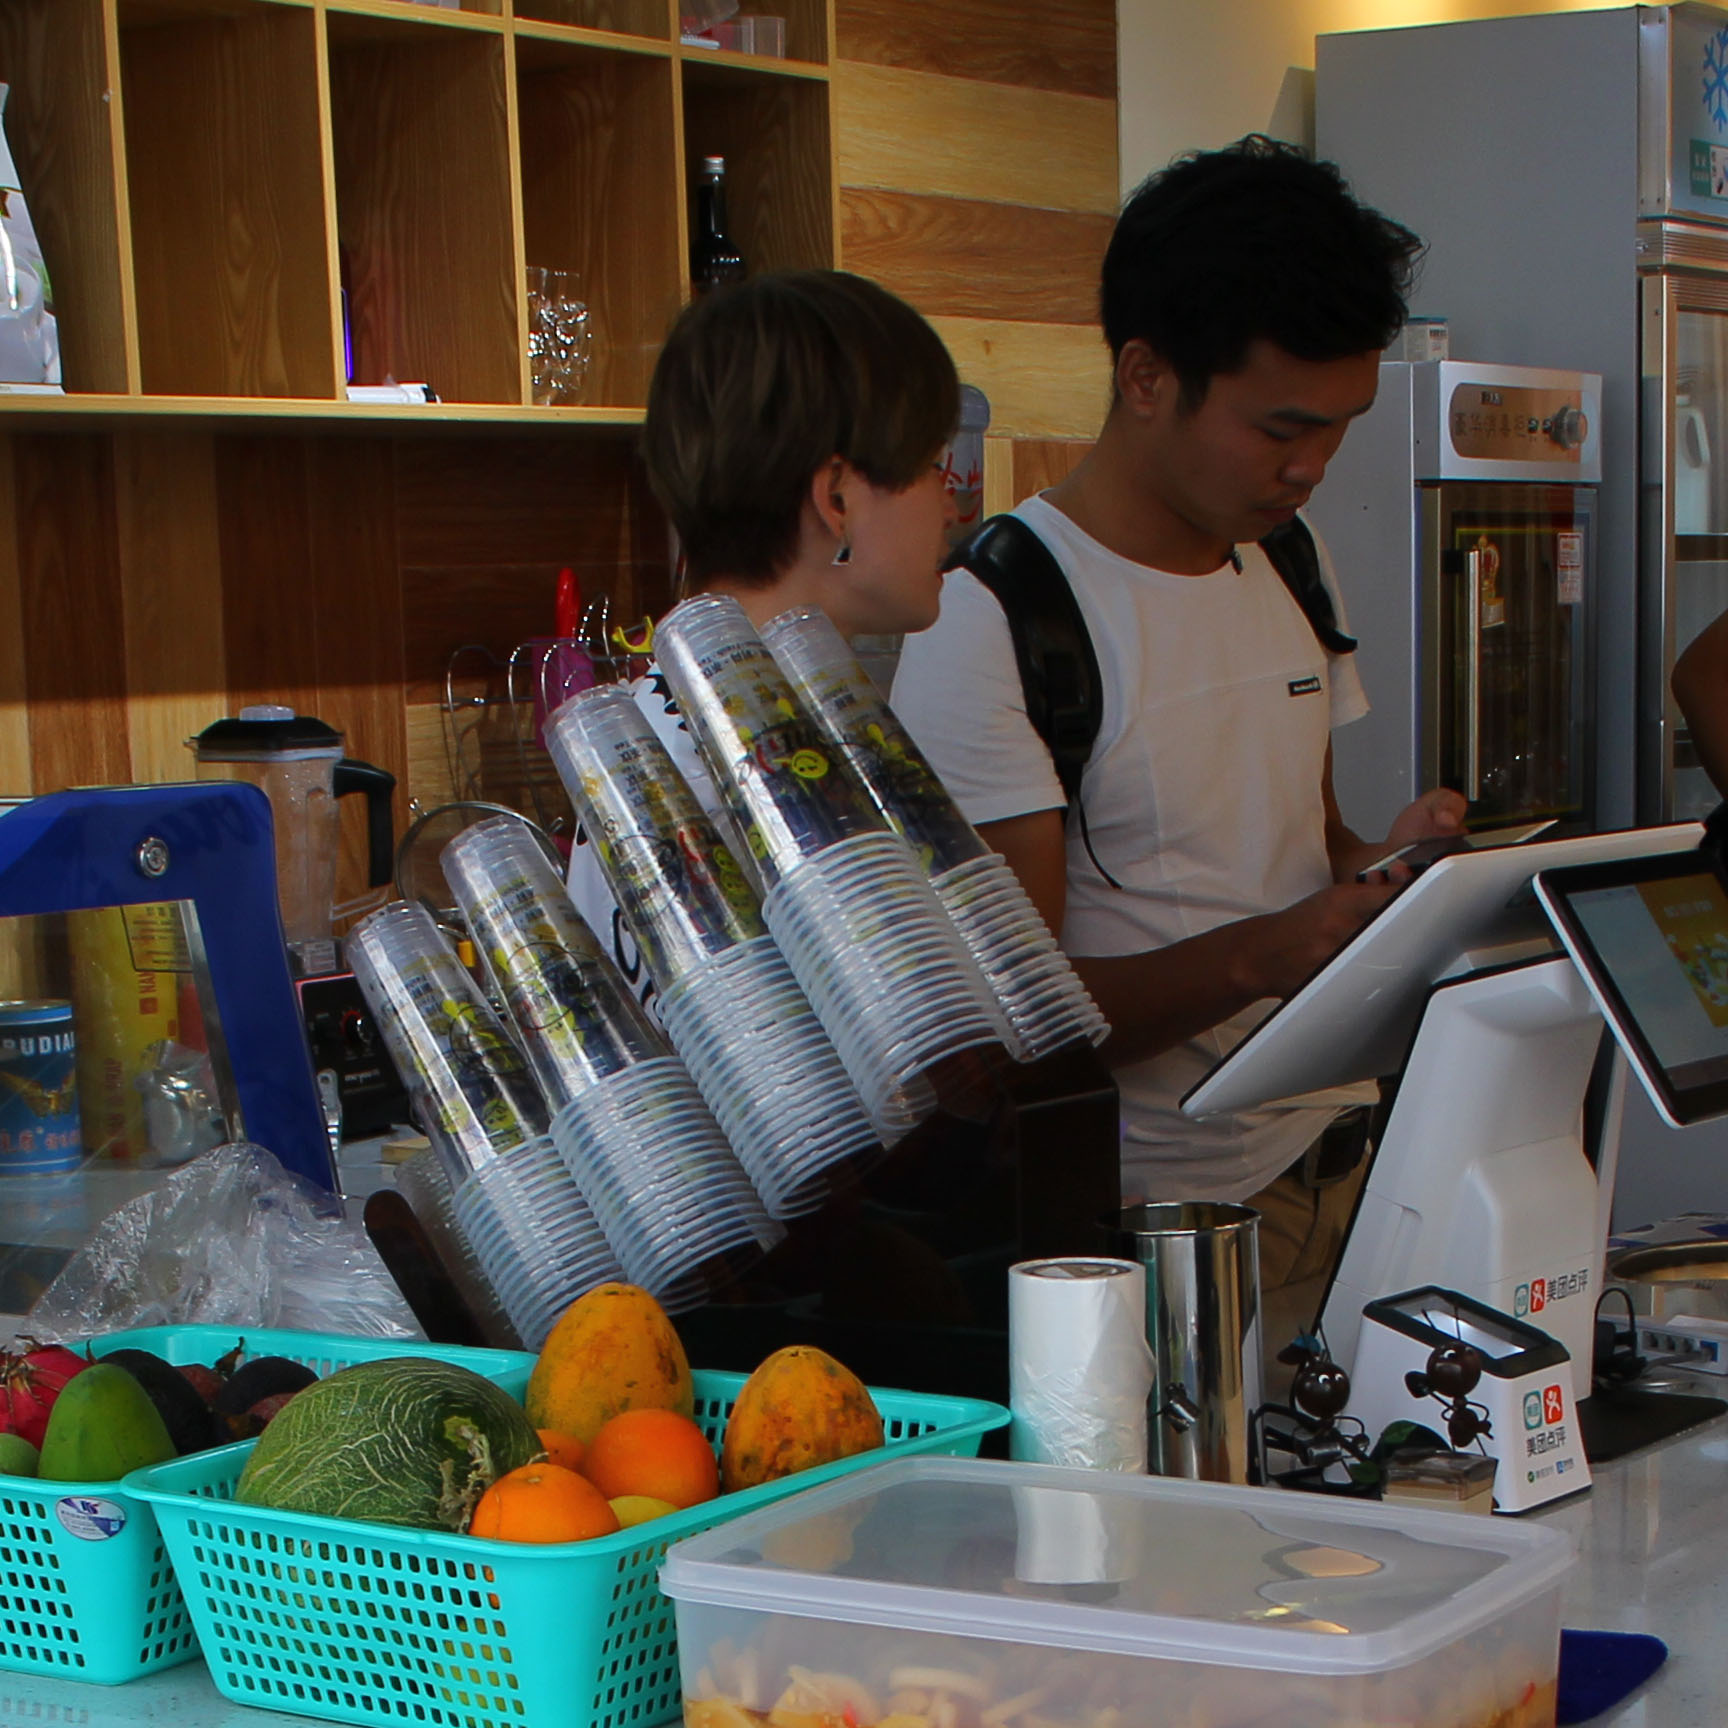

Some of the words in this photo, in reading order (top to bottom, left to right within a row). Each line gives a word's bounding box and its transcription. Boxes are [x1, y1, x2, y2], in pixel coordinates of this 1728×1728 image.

[1545, 1268, 1589, 1304] 美团点评
[1525, 1425, 1568, 1459] 美团点评
